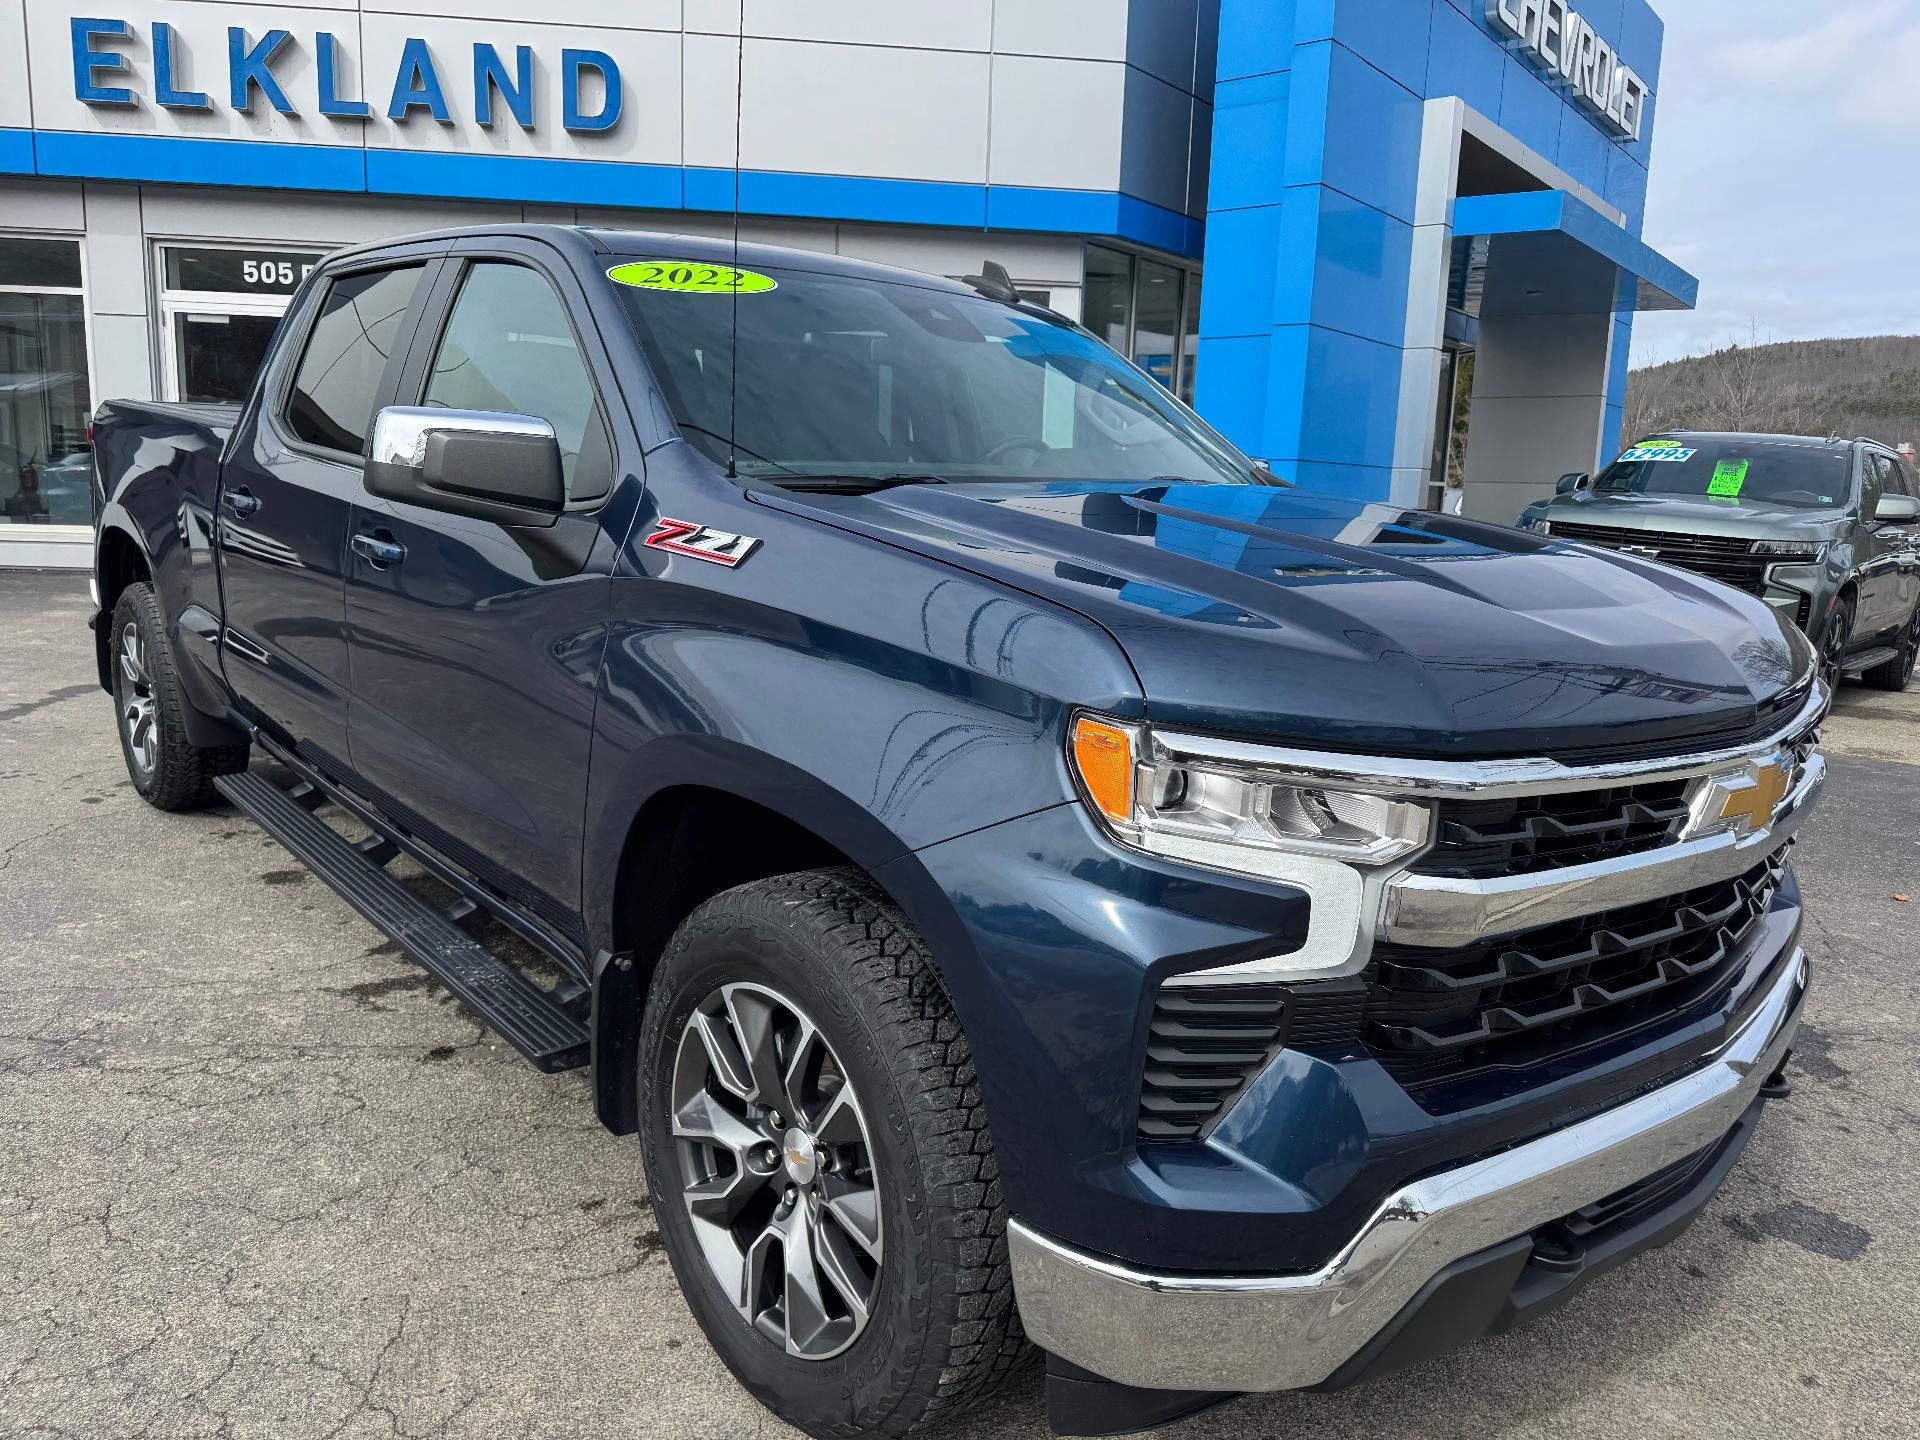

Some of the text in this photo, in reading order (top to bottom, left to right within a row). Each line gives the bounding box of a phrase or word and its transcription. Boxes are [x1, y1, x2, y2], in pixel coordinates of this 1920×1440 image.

[70, 17, 624, 133] ELKLAND
[243, 260, 294, 285] 505
[640, 267, 745, 287] 2022
[1620, 448, 1694, 460] 62995
[642, 517, 764, 569] Z71
